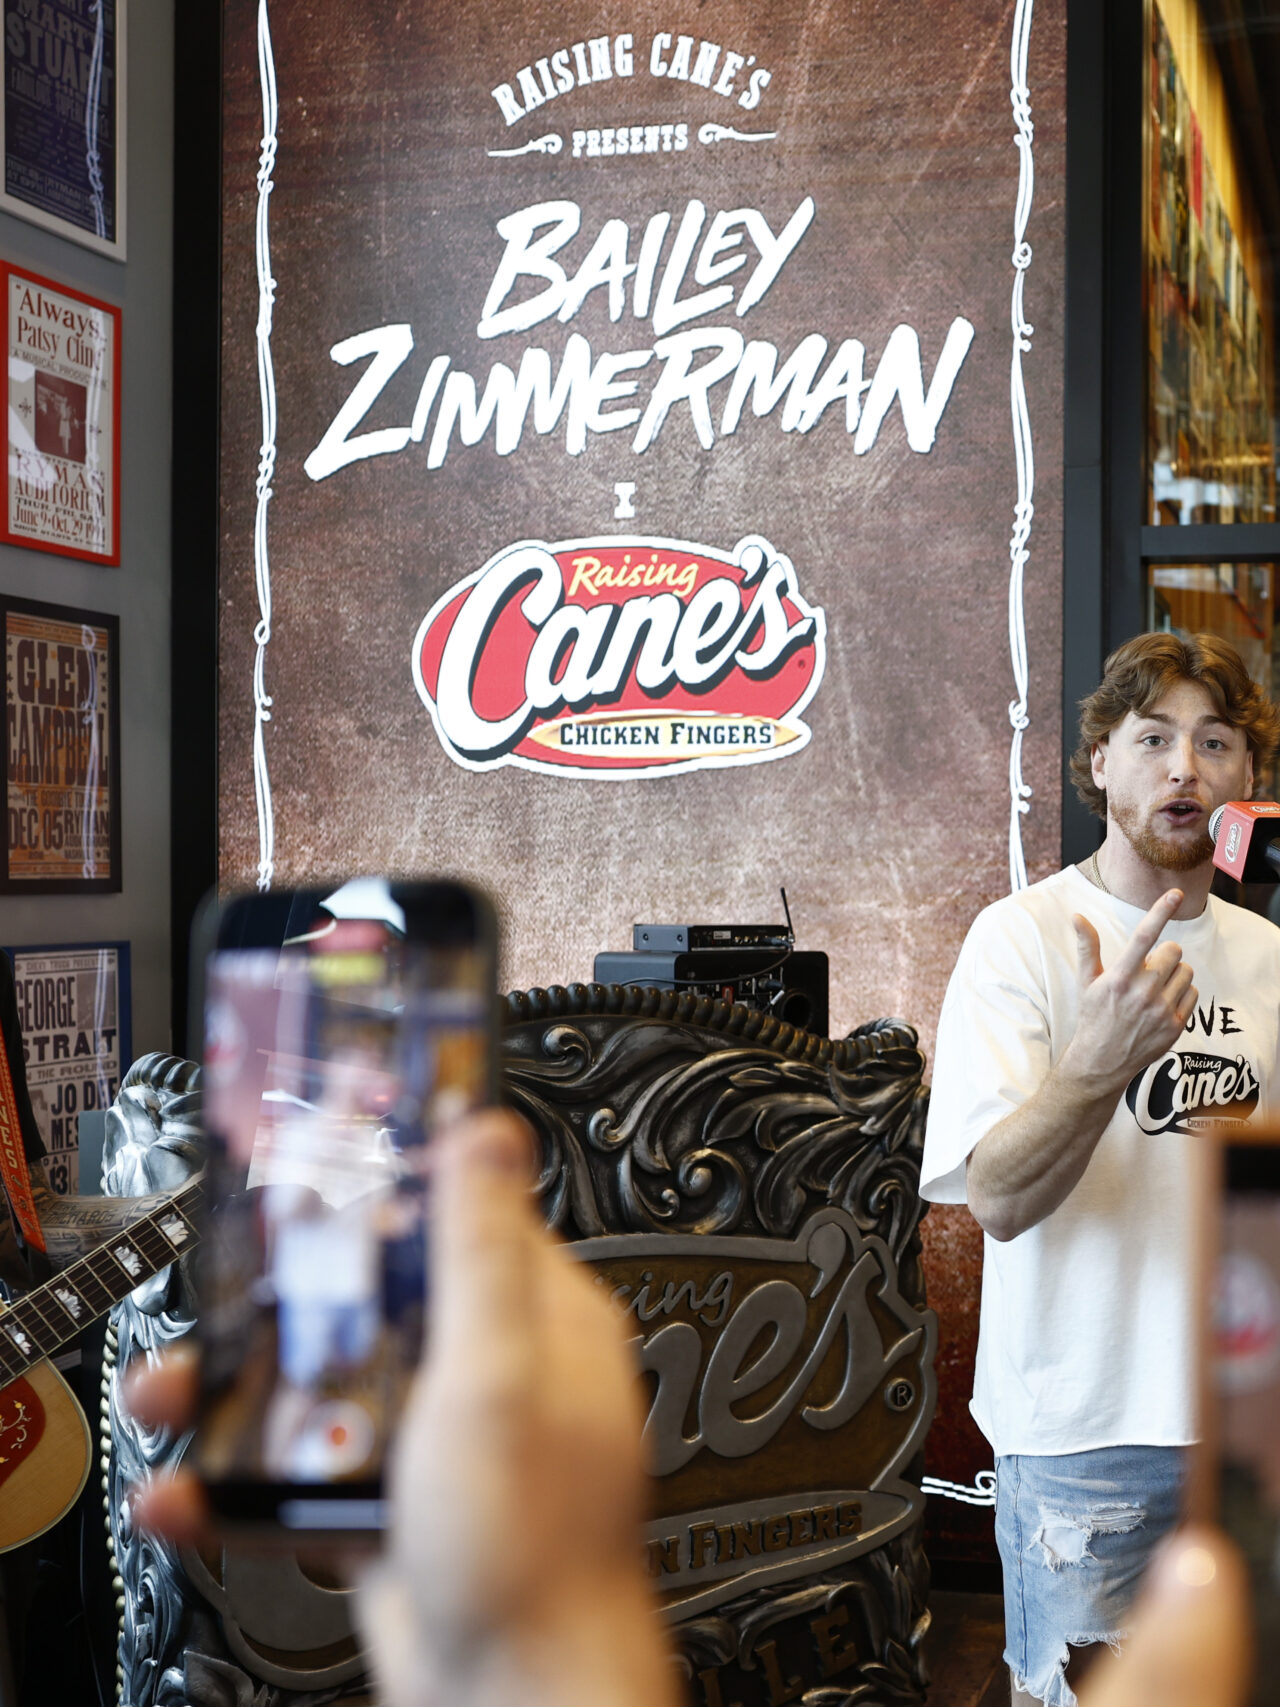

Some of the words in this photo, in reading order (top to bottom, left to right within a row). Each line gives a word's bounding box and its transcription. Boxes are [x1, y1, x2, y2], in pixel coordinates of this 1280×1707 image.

[491, 33, 635, 126] RAISING
[649, 32, 773, 110] CANE'S
[571, 123, 689, 158] PRESENTS
[476, 196, 815, 340] BAILEY
[17, 315, 60, 360] Patsy
[303, 316, 976, 482] ZIMMERMAN
[568, 554, 700, 598] Raising
[436, 545, 818, 752] Cane's
[560, 722, 660, 746] CHICKEN
[670, 722, 773, 746] FINGERS
[8, 808, 39, 851] DEC
[43, 808, 63, 850] 05
[64, 809, 110, 835] RYAN
[1184, 1056, 1222, 1073] Raising
[51, 1083, 77, 1115] JO
[1135, 1051, 1260, 1132] Cane's
[688, 1500, 863, 1570] FINGERS
